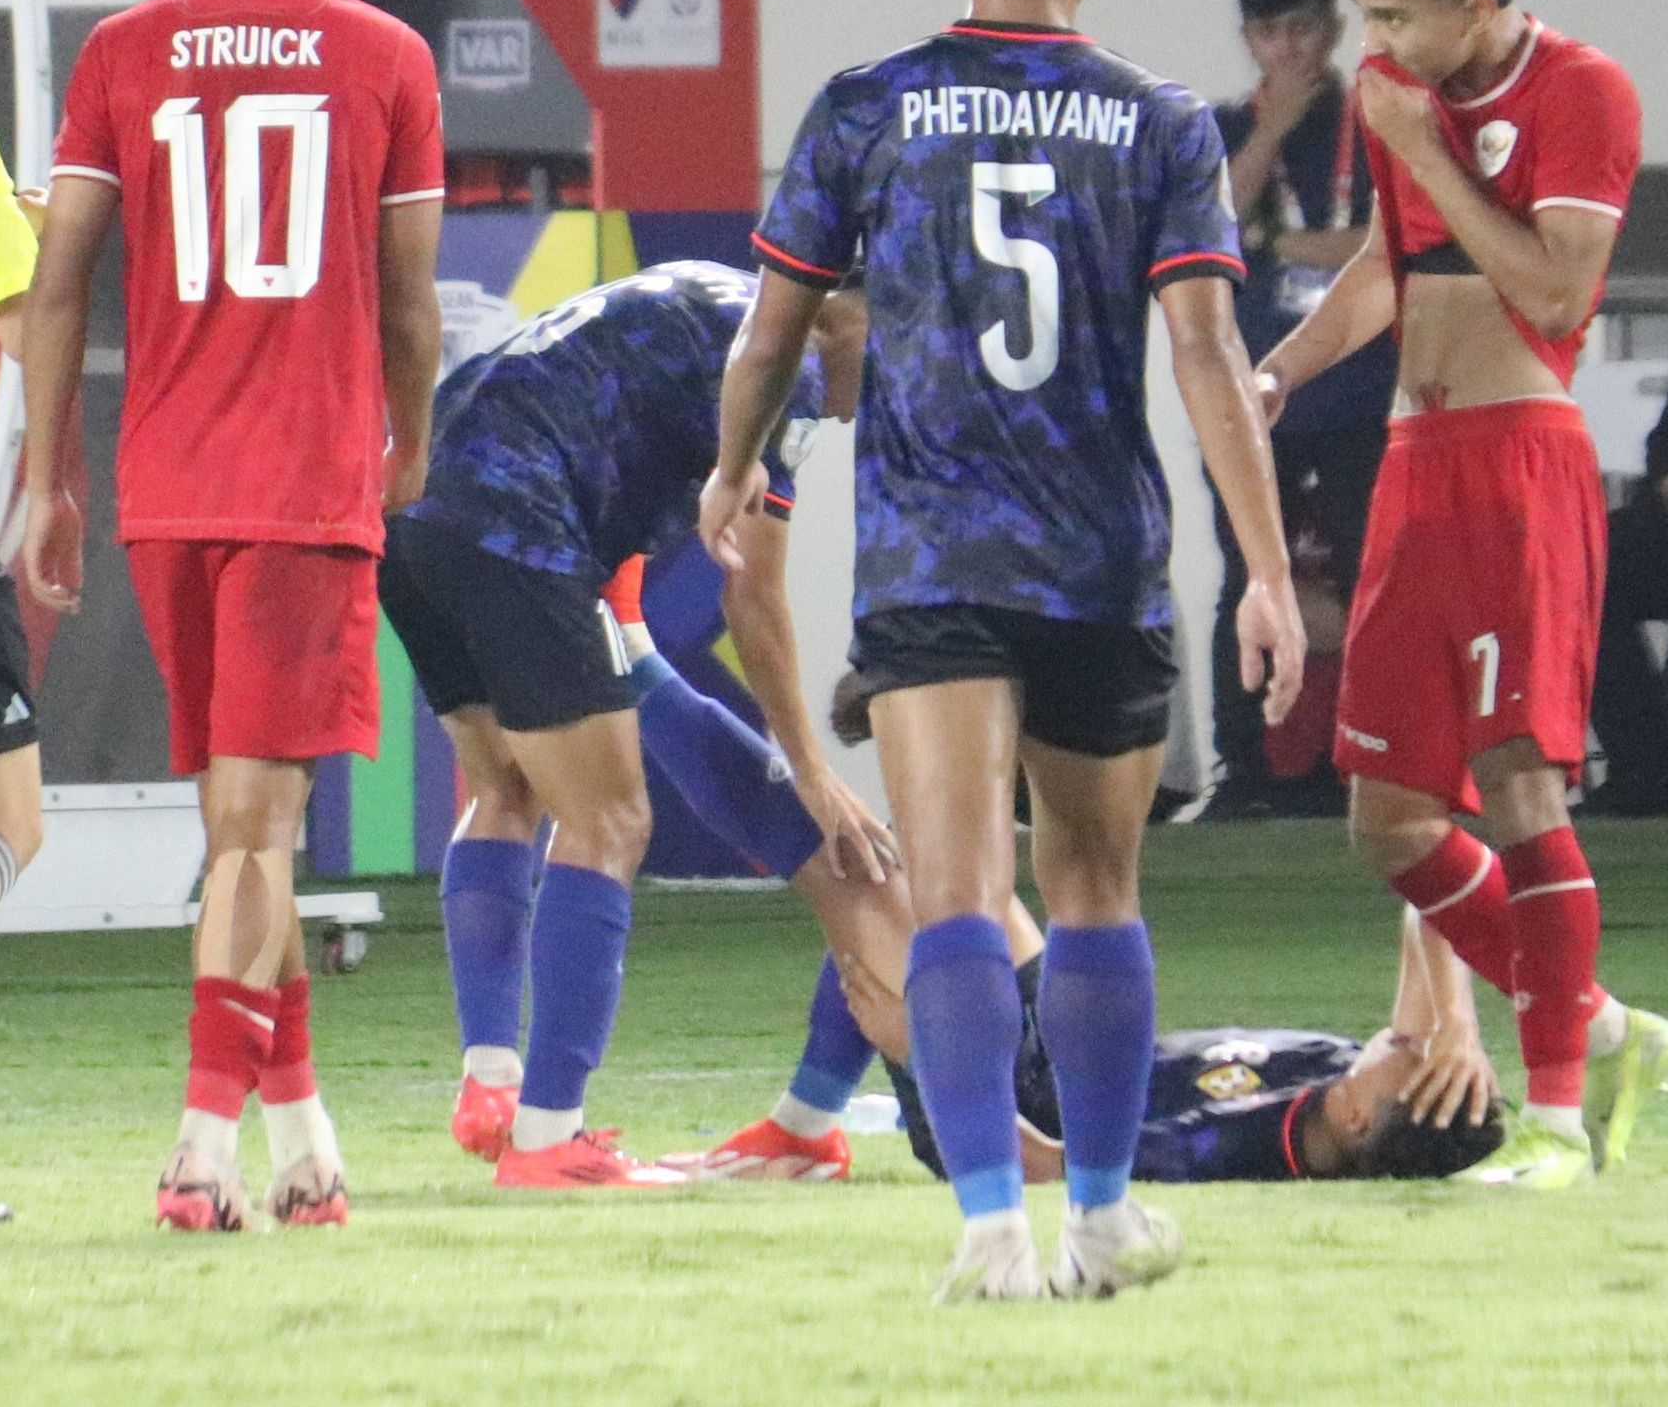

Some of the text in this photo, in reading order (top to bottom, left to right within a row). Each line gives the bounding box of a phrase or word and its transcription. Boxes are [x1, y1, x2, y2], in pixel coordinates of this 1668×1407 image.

[170, 25, 323, 69] STRUICK
[459, 34, 520, 68] VAR
[902, 86, 1139, 148] PHETDAVANH
[152, 93, 330, 302] 10
[972, 161, 1060, 392] 5
